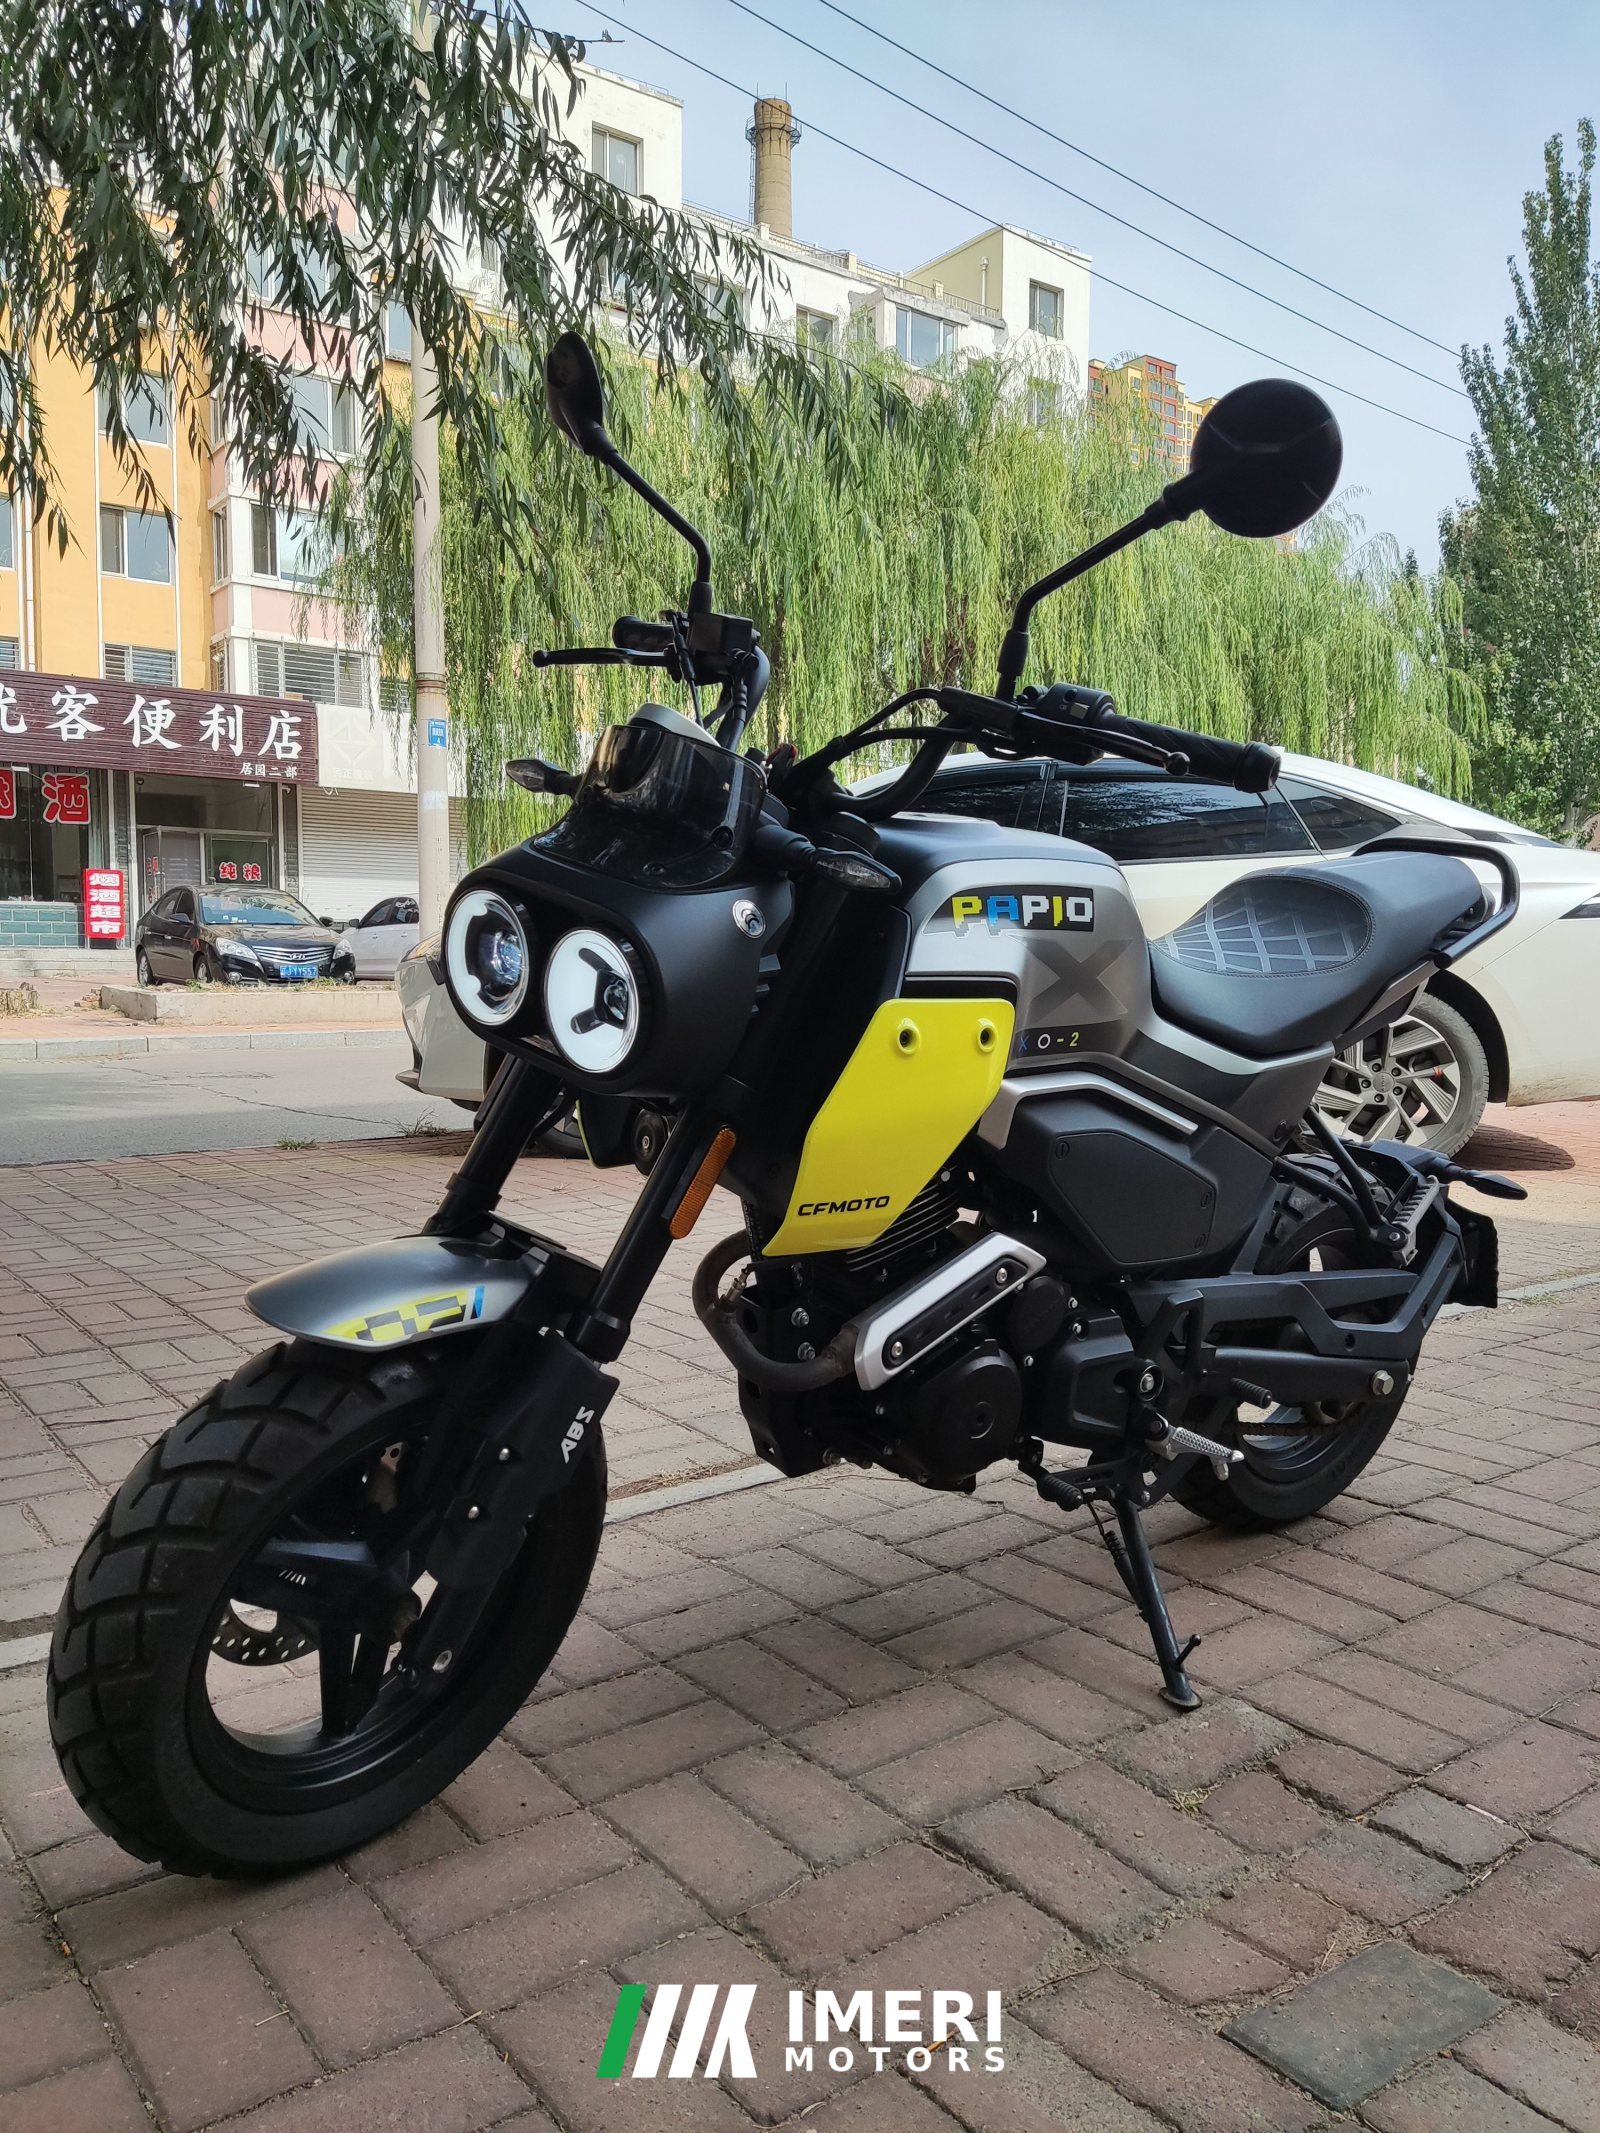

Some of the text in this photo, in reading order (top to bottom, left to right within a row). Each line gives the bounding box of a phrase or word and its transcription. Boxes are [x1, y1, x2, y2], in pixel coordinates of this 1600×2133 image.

[240, 762, 297, 779] 居园二部
[219, 861, 261, 881] 纯粮
[89, 873, 121, 934] 烟酒超市
[952, 895, 1093, 928] PAPIO
[797, 1195, 890, 1217] CFMOTO
[561, 1405, 595, 1465] ABS
